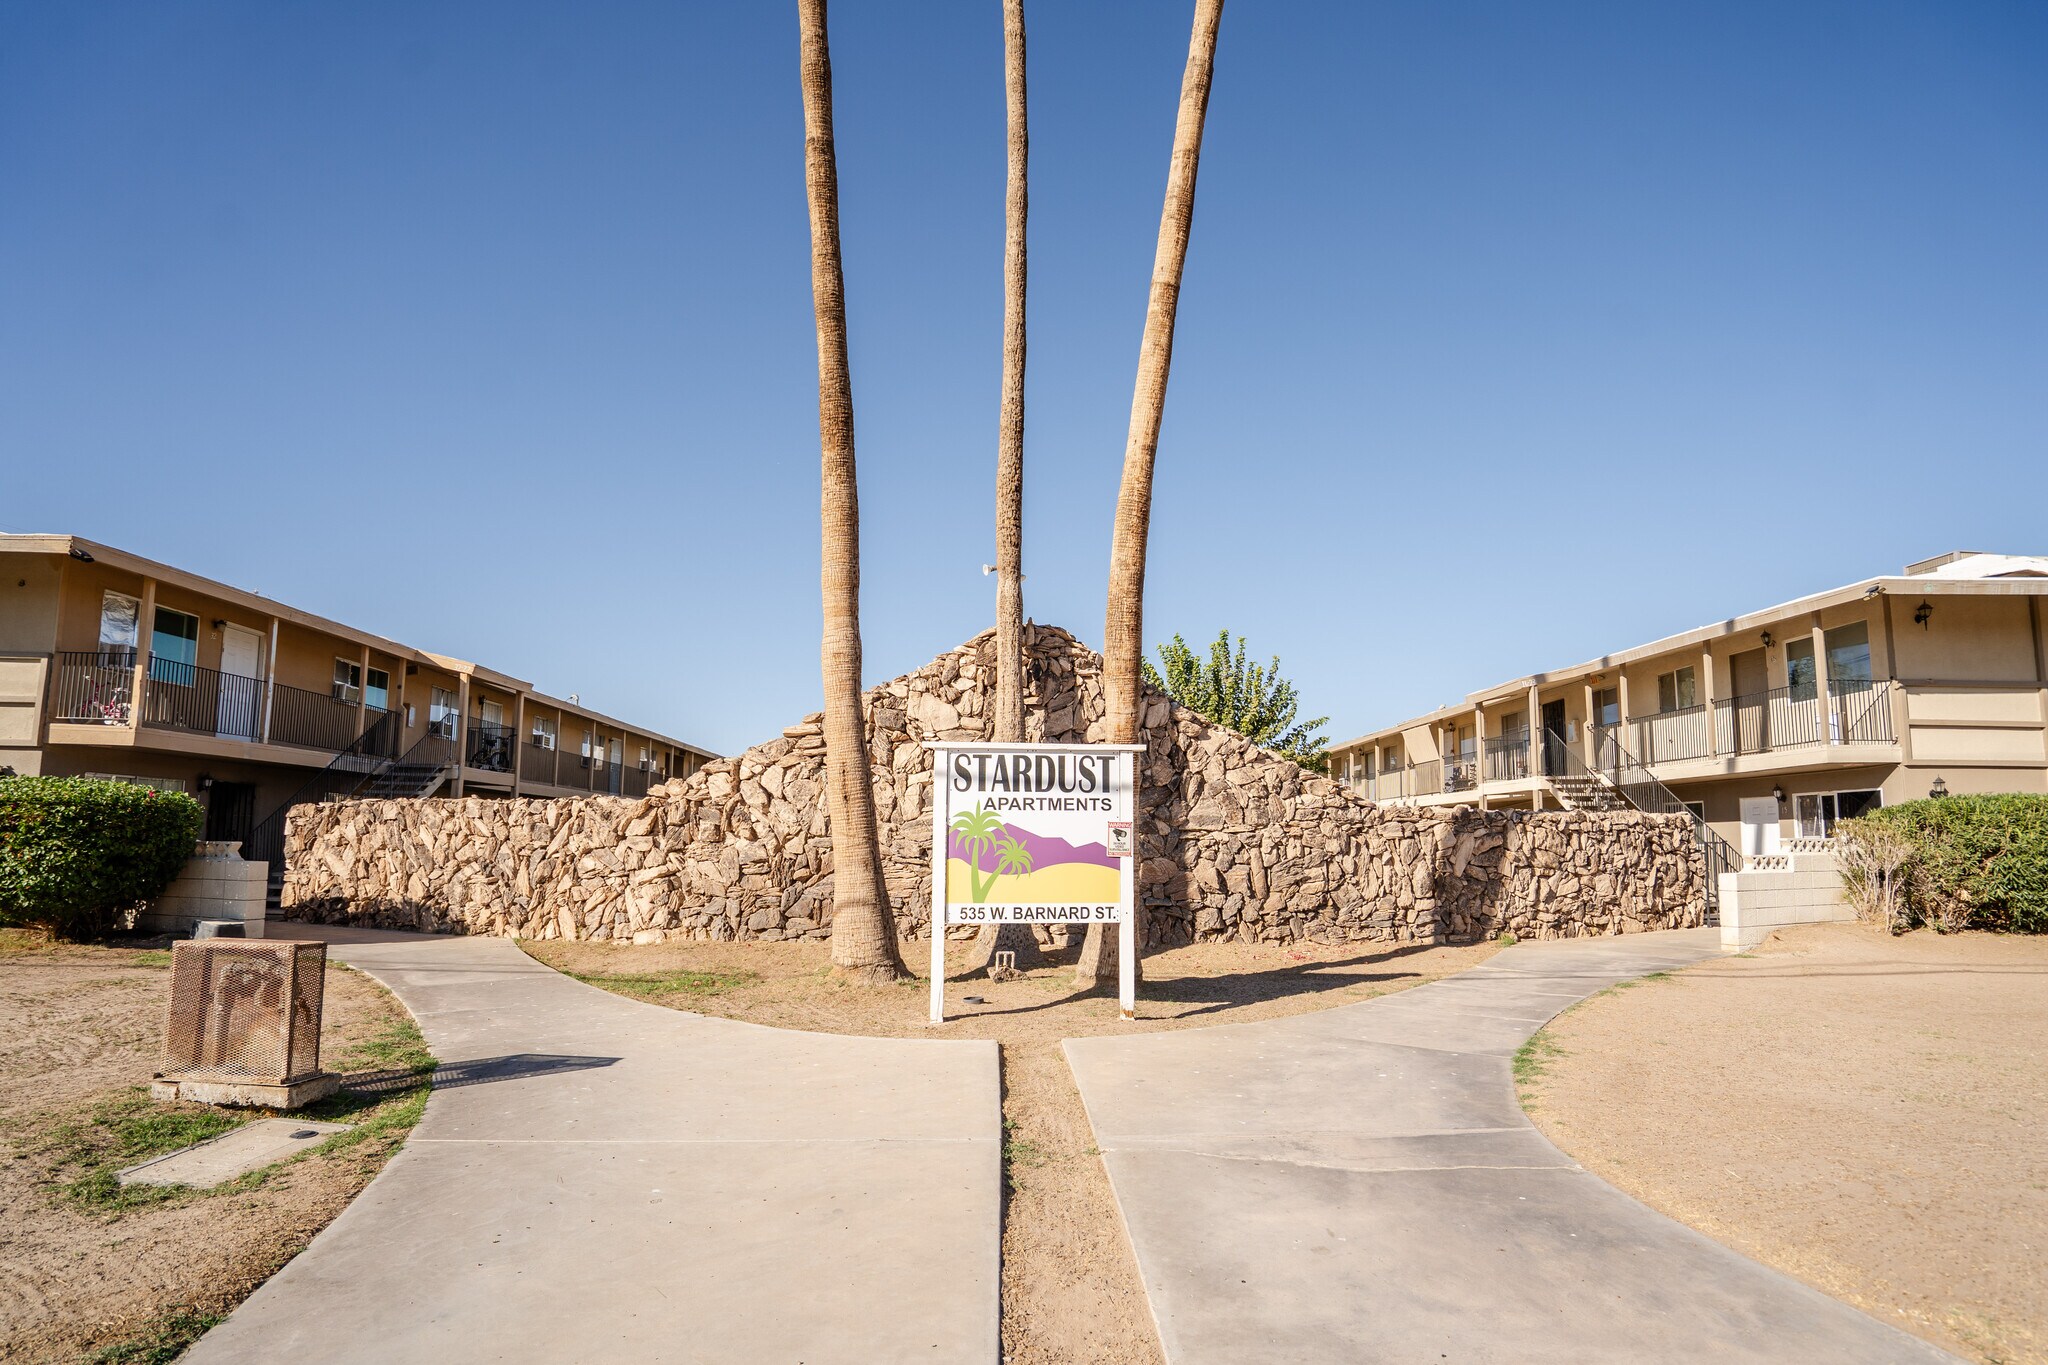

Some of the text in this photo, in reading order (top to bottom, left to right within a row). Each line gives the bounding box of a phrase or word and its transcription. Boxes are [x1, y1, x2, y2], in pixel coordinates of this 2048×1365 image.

[953, 753, 1116, 794] STARDUST
[983, 797, 1112, 811] APARTMENTS
[959, 906, 1116, 920] 535 W. BARNARD ST.
